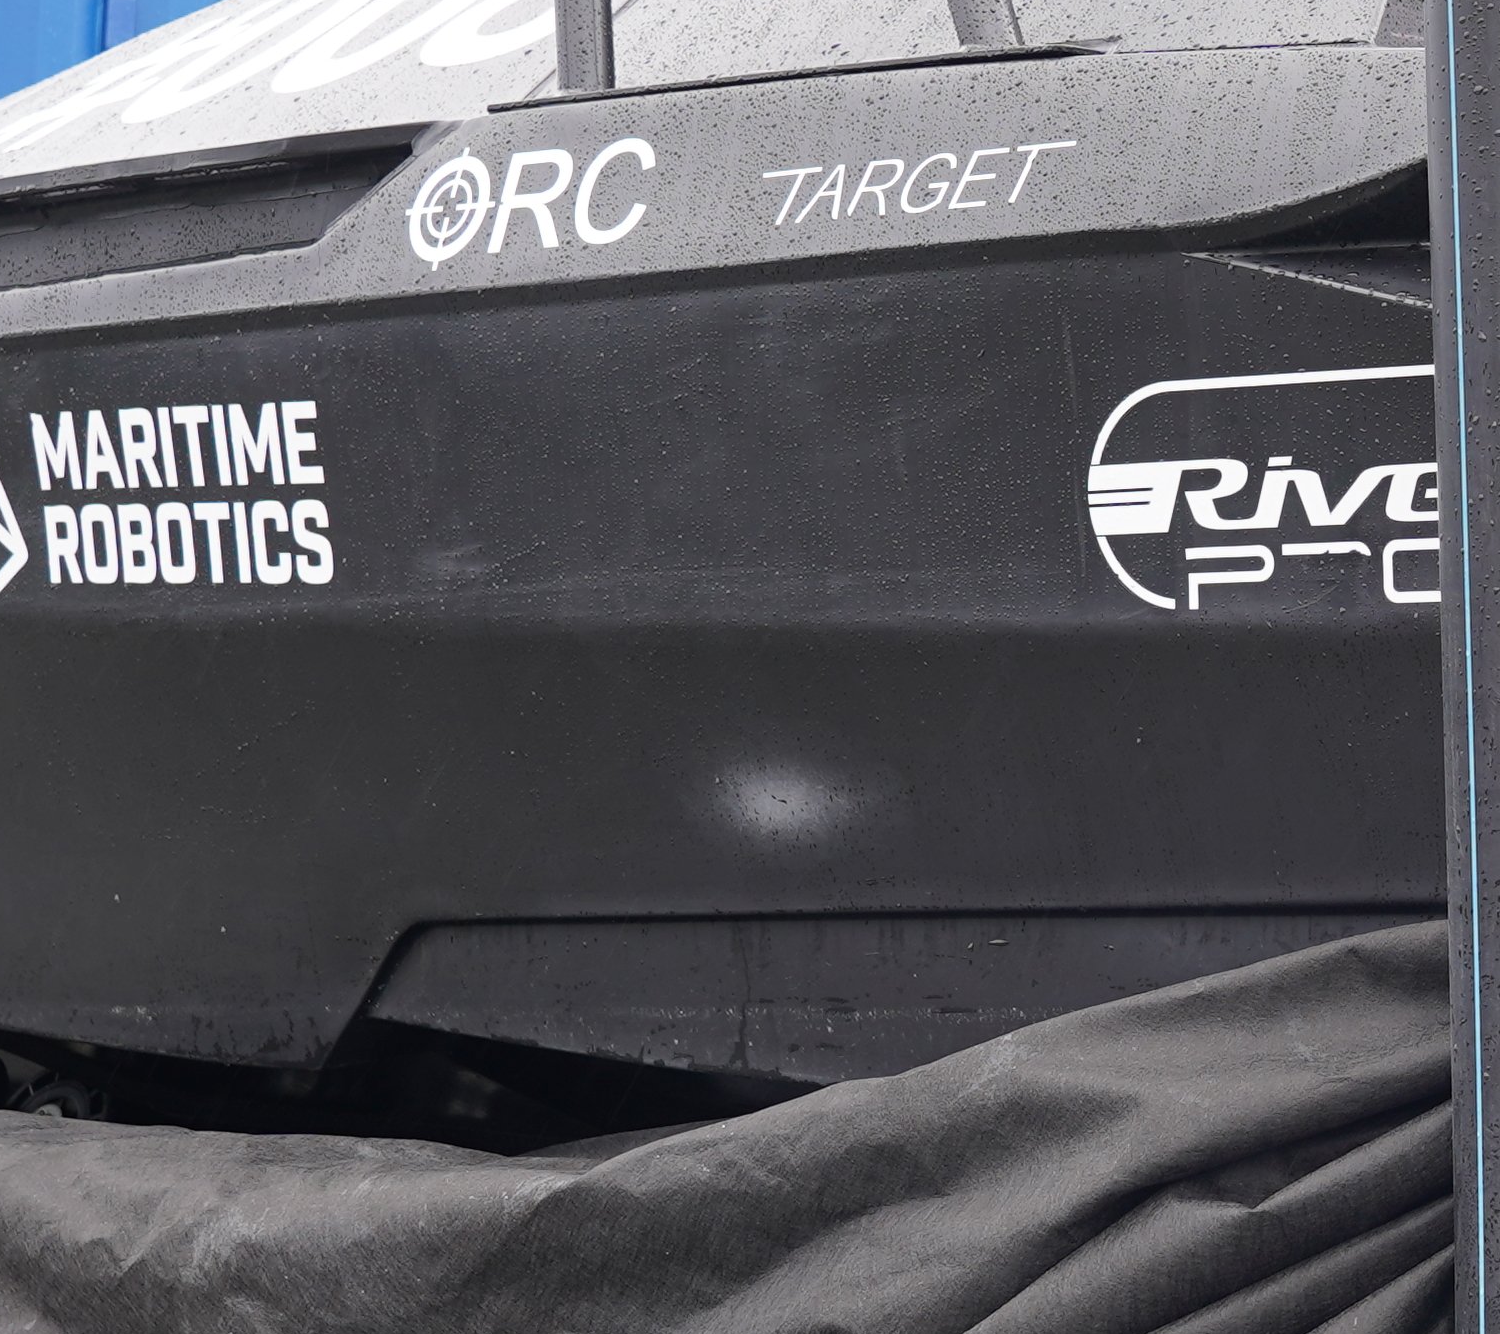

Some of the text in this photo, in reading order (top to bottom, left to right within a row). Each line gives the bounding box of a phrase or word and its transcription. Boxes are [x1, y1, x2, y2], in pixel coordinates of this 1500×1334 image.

[762, 140, 1077, 226] TARGET
[29, 400, 326, 491] MARITIME
[43, 499, 335, 585] ROBOTICS
